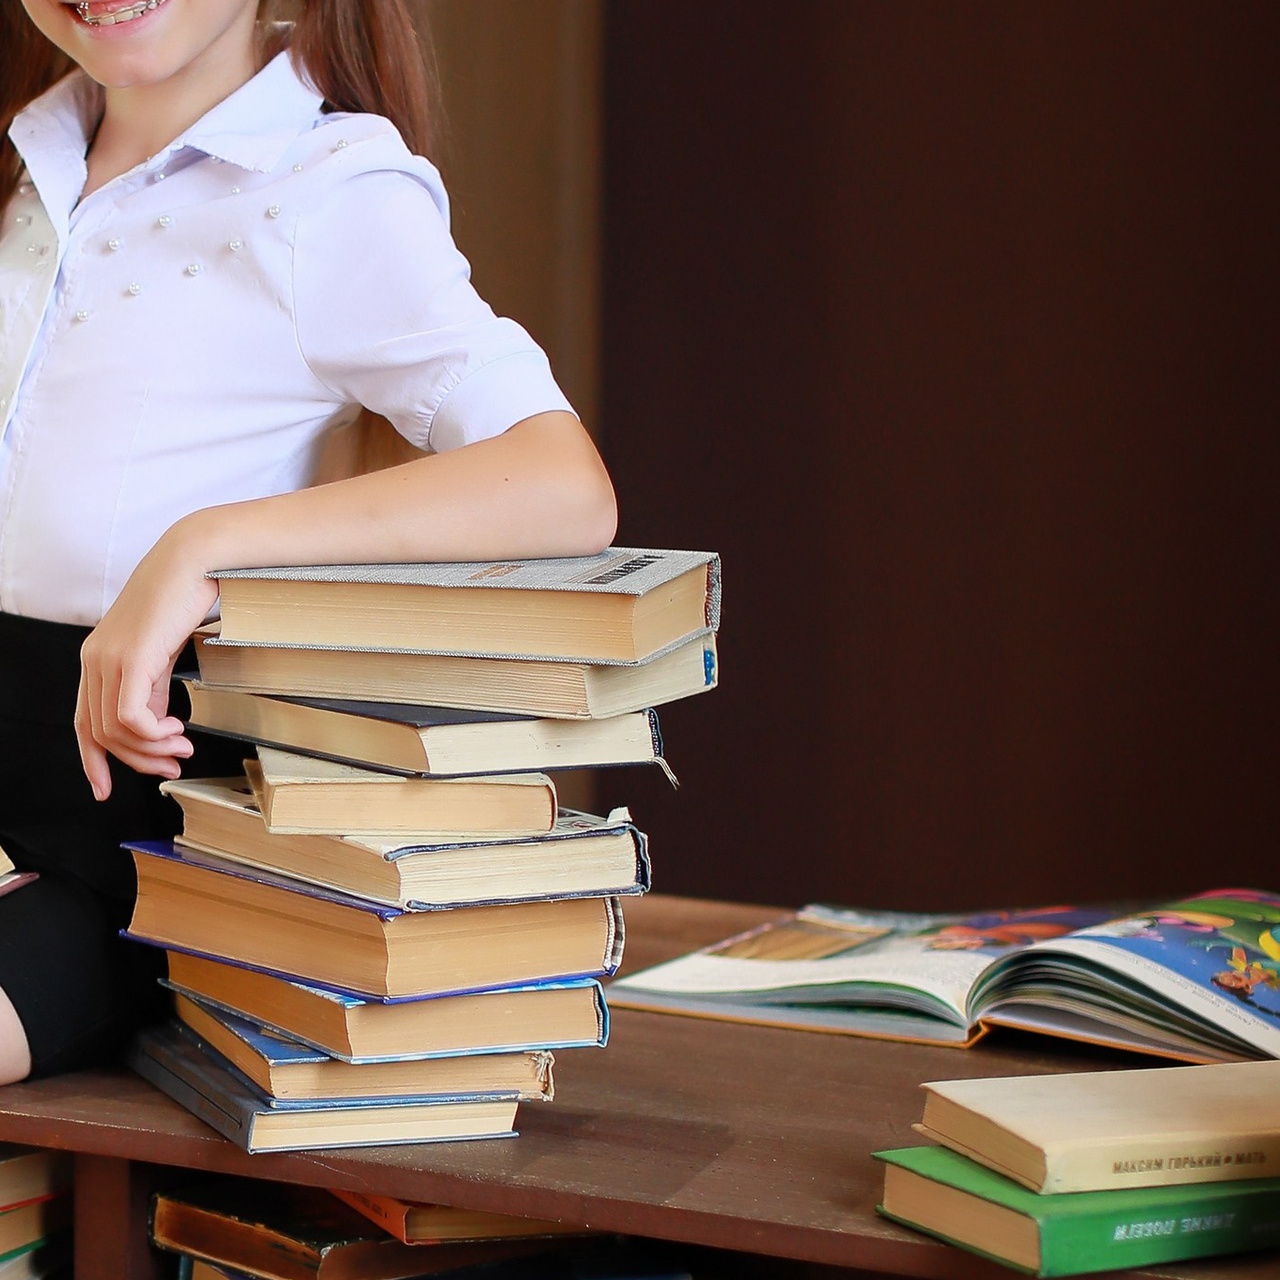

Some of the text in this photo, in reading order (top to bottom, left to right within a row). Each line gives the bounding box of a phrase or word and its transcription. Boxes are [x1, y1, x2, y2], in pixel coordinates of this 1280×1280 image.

[1112, 1151, 1267, 1174] МАКСИМ ГОРЬКИЙ МАТЬ
